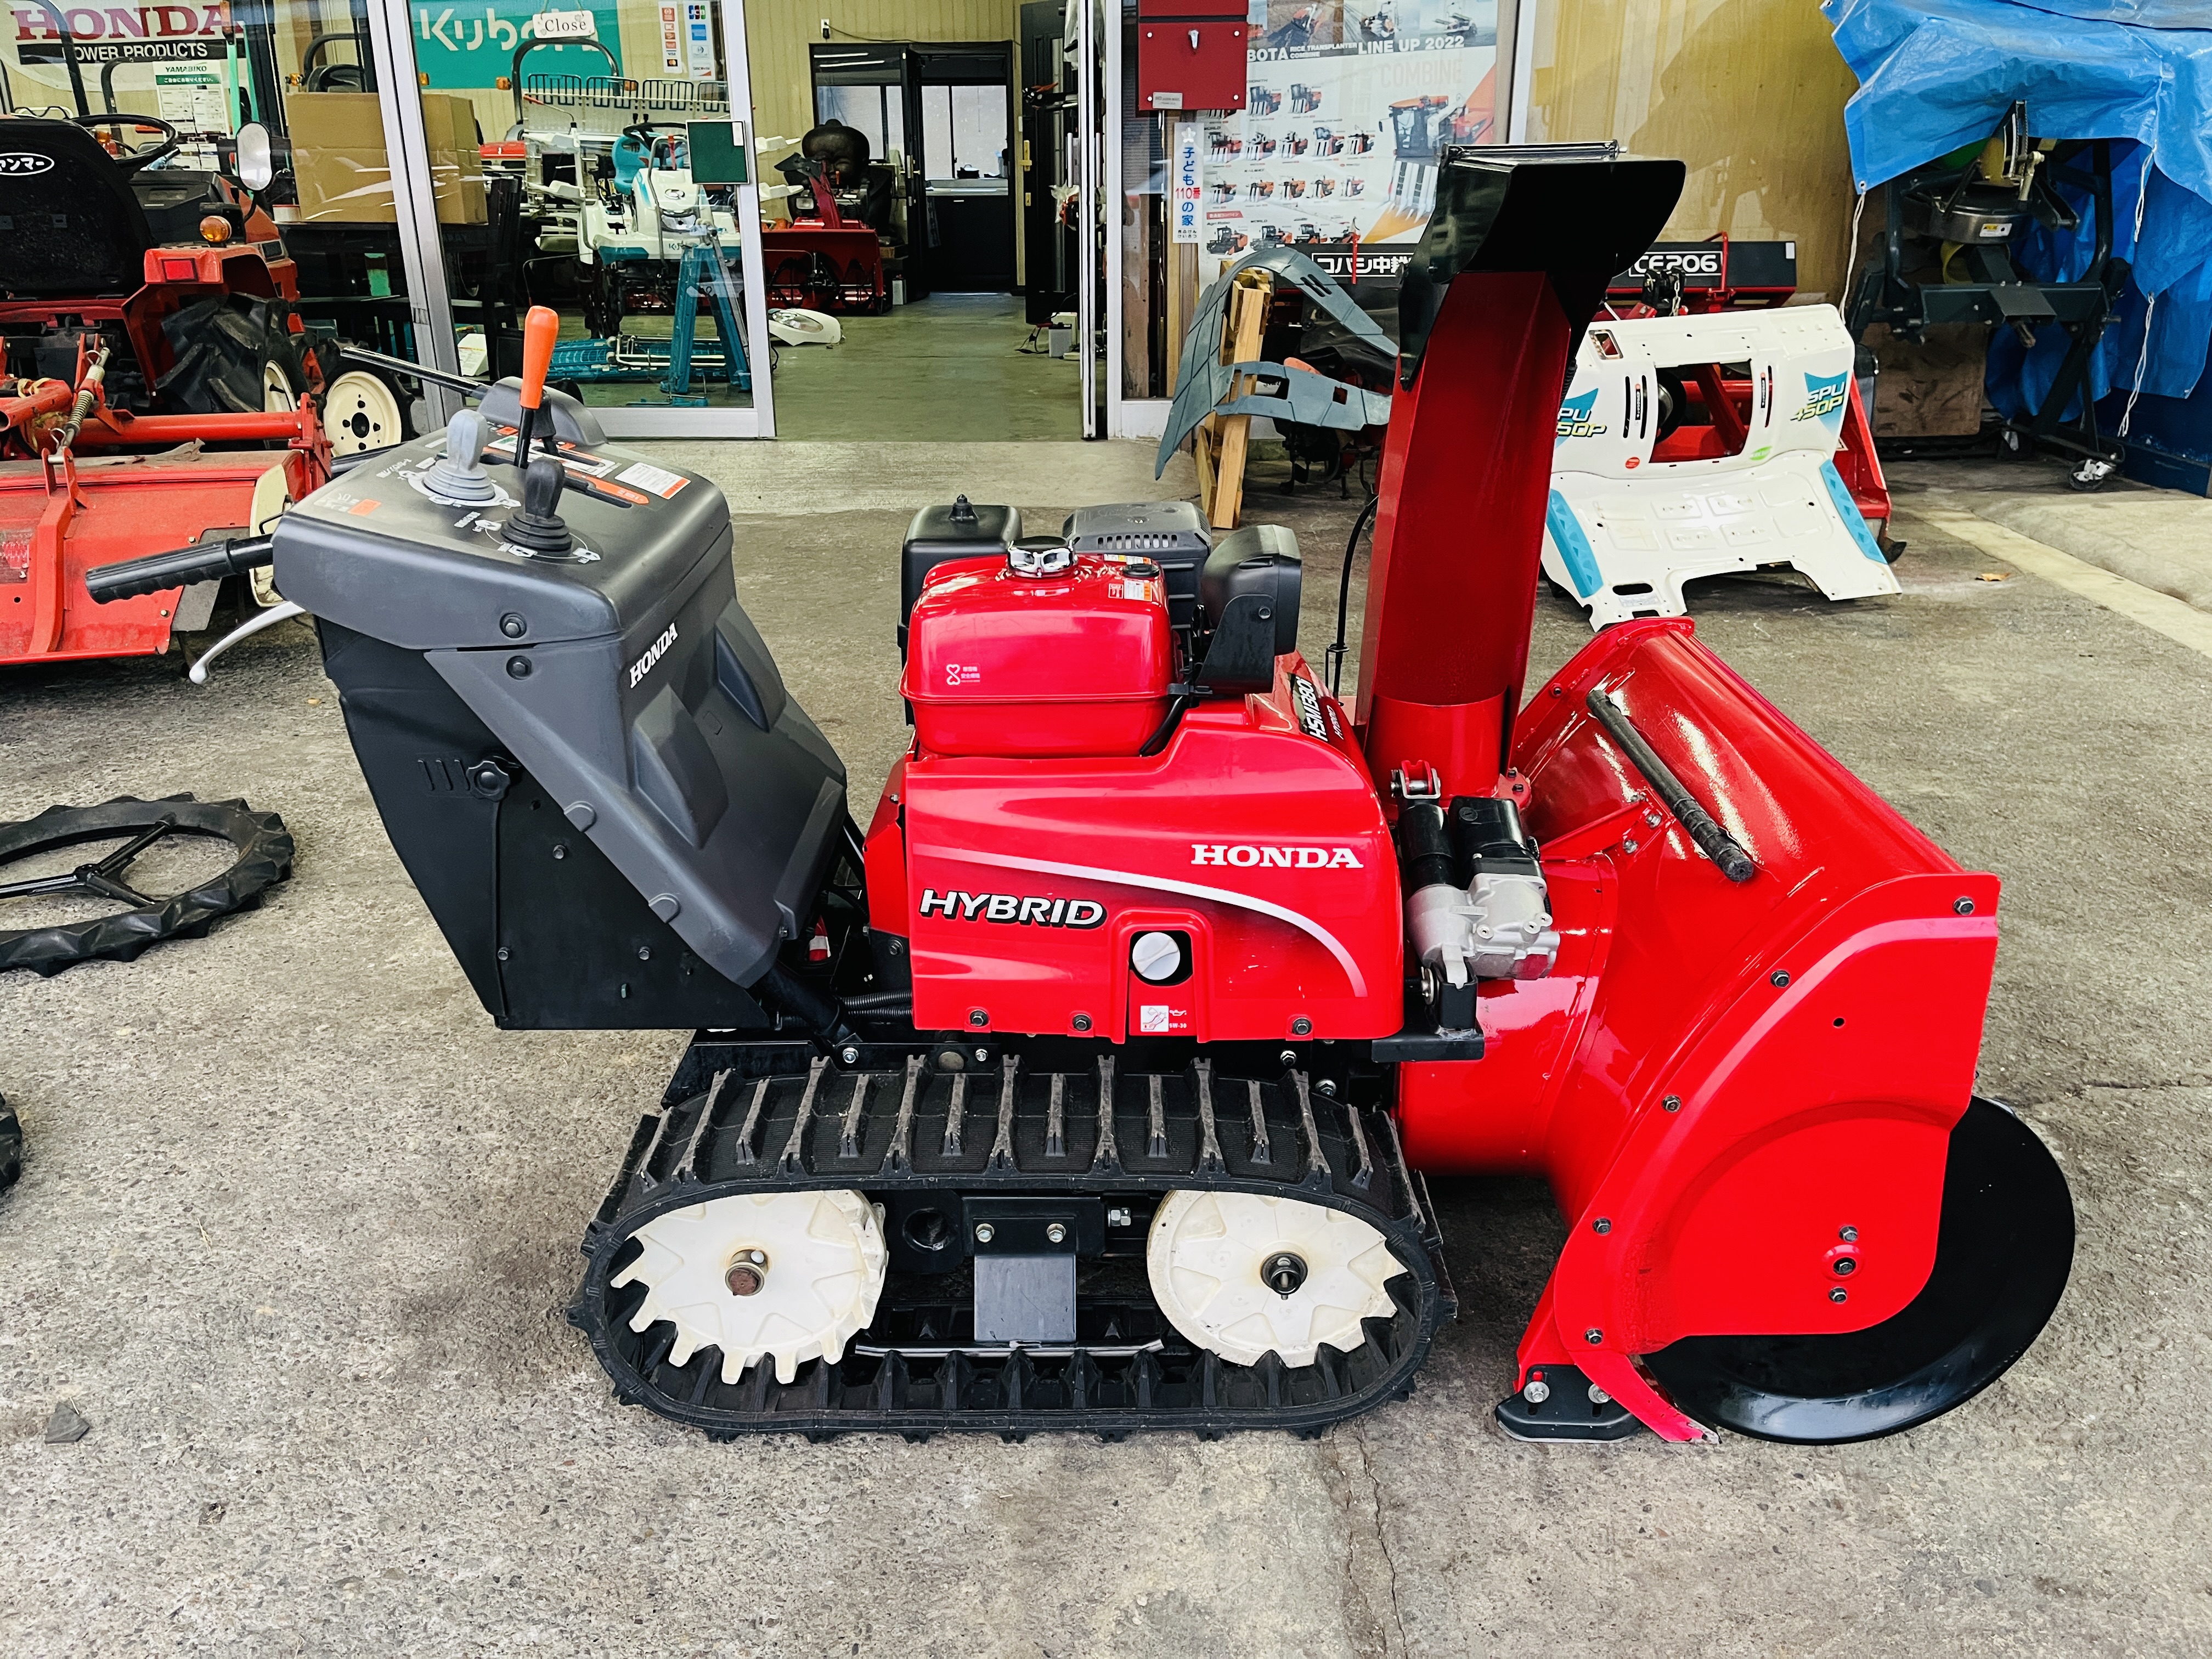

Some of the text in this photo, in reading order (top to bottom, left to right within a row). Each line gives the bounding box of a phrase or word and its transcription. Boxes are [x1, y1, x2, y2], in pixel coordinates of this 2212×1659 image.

[10, 5, 244, 40] HONDA
[689, 5, 706, 19] JCB
[420, 8, 600, 51] Kub
[545, 19, 586, 32] Close
[62, 43, 208, 61] OWER PRODUCTS
[1247, 47, 1289, 62] BOTA
[1307, 42, 1358, 51] TRANSPLANTER
[1358, 36, 1465, 55] LINE UP 2022
[1381, 59, 1463, 88] COMBINE
[1176, 147, 1200, 226] 子ども110番の家
[1317, 256, 1412, 273] コバシ中耕
[1807, 382, 1844, 404] SPU
[1557, 407, 1592, 422] PU
[629, 622, 678, 689] HONDA
[1295, 676, 1328, 742] HSM1380i
[1191, 844, 1364, 868] HONDA
[919, 889, 1107, 929] HYBRID
